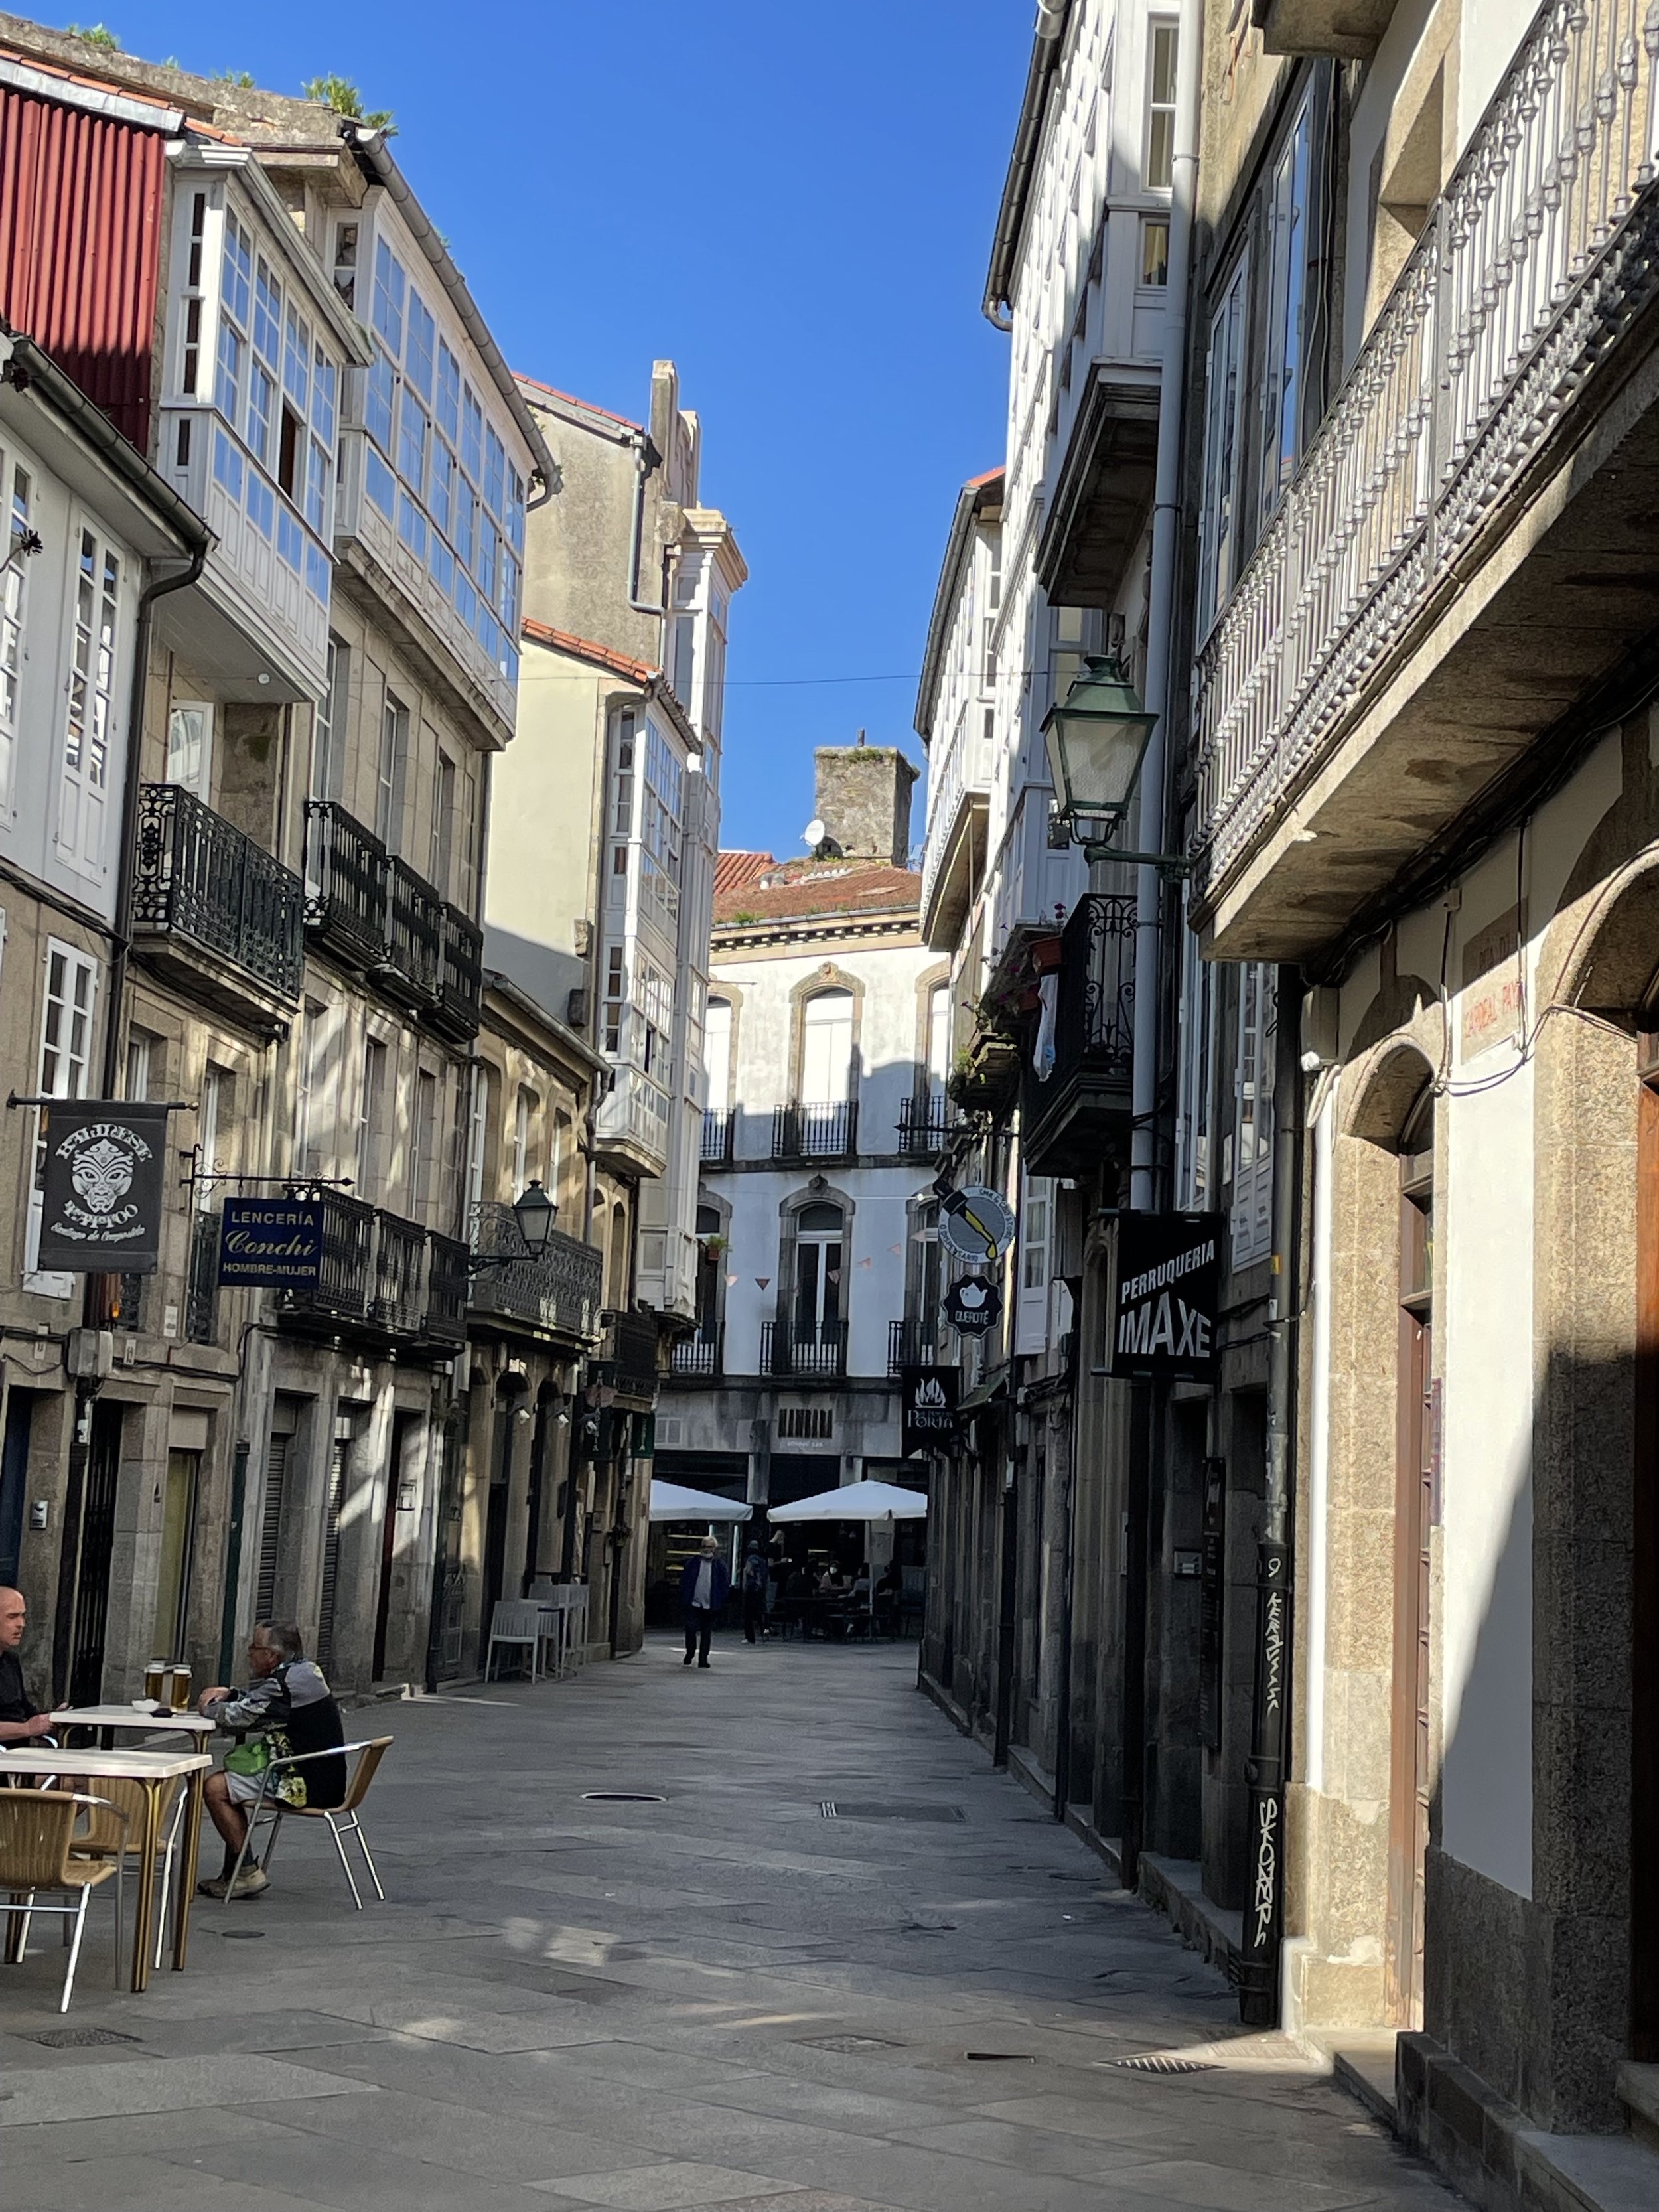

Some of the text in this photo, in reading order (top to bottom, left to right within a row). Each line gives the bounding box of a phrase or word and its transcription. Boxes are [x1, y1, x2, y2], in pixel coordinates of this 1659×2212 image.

[231, 1211, 314, 1226] LENCERÍA
[225, 1230, 318, 1256] Conchi
[222, 1262, 316, 1276] HOMBRE-MUJER
[1121, 1239, 1214, 1304] PERRUQUERIA
[1118, 1291, 1212, 1358] IMAXE
